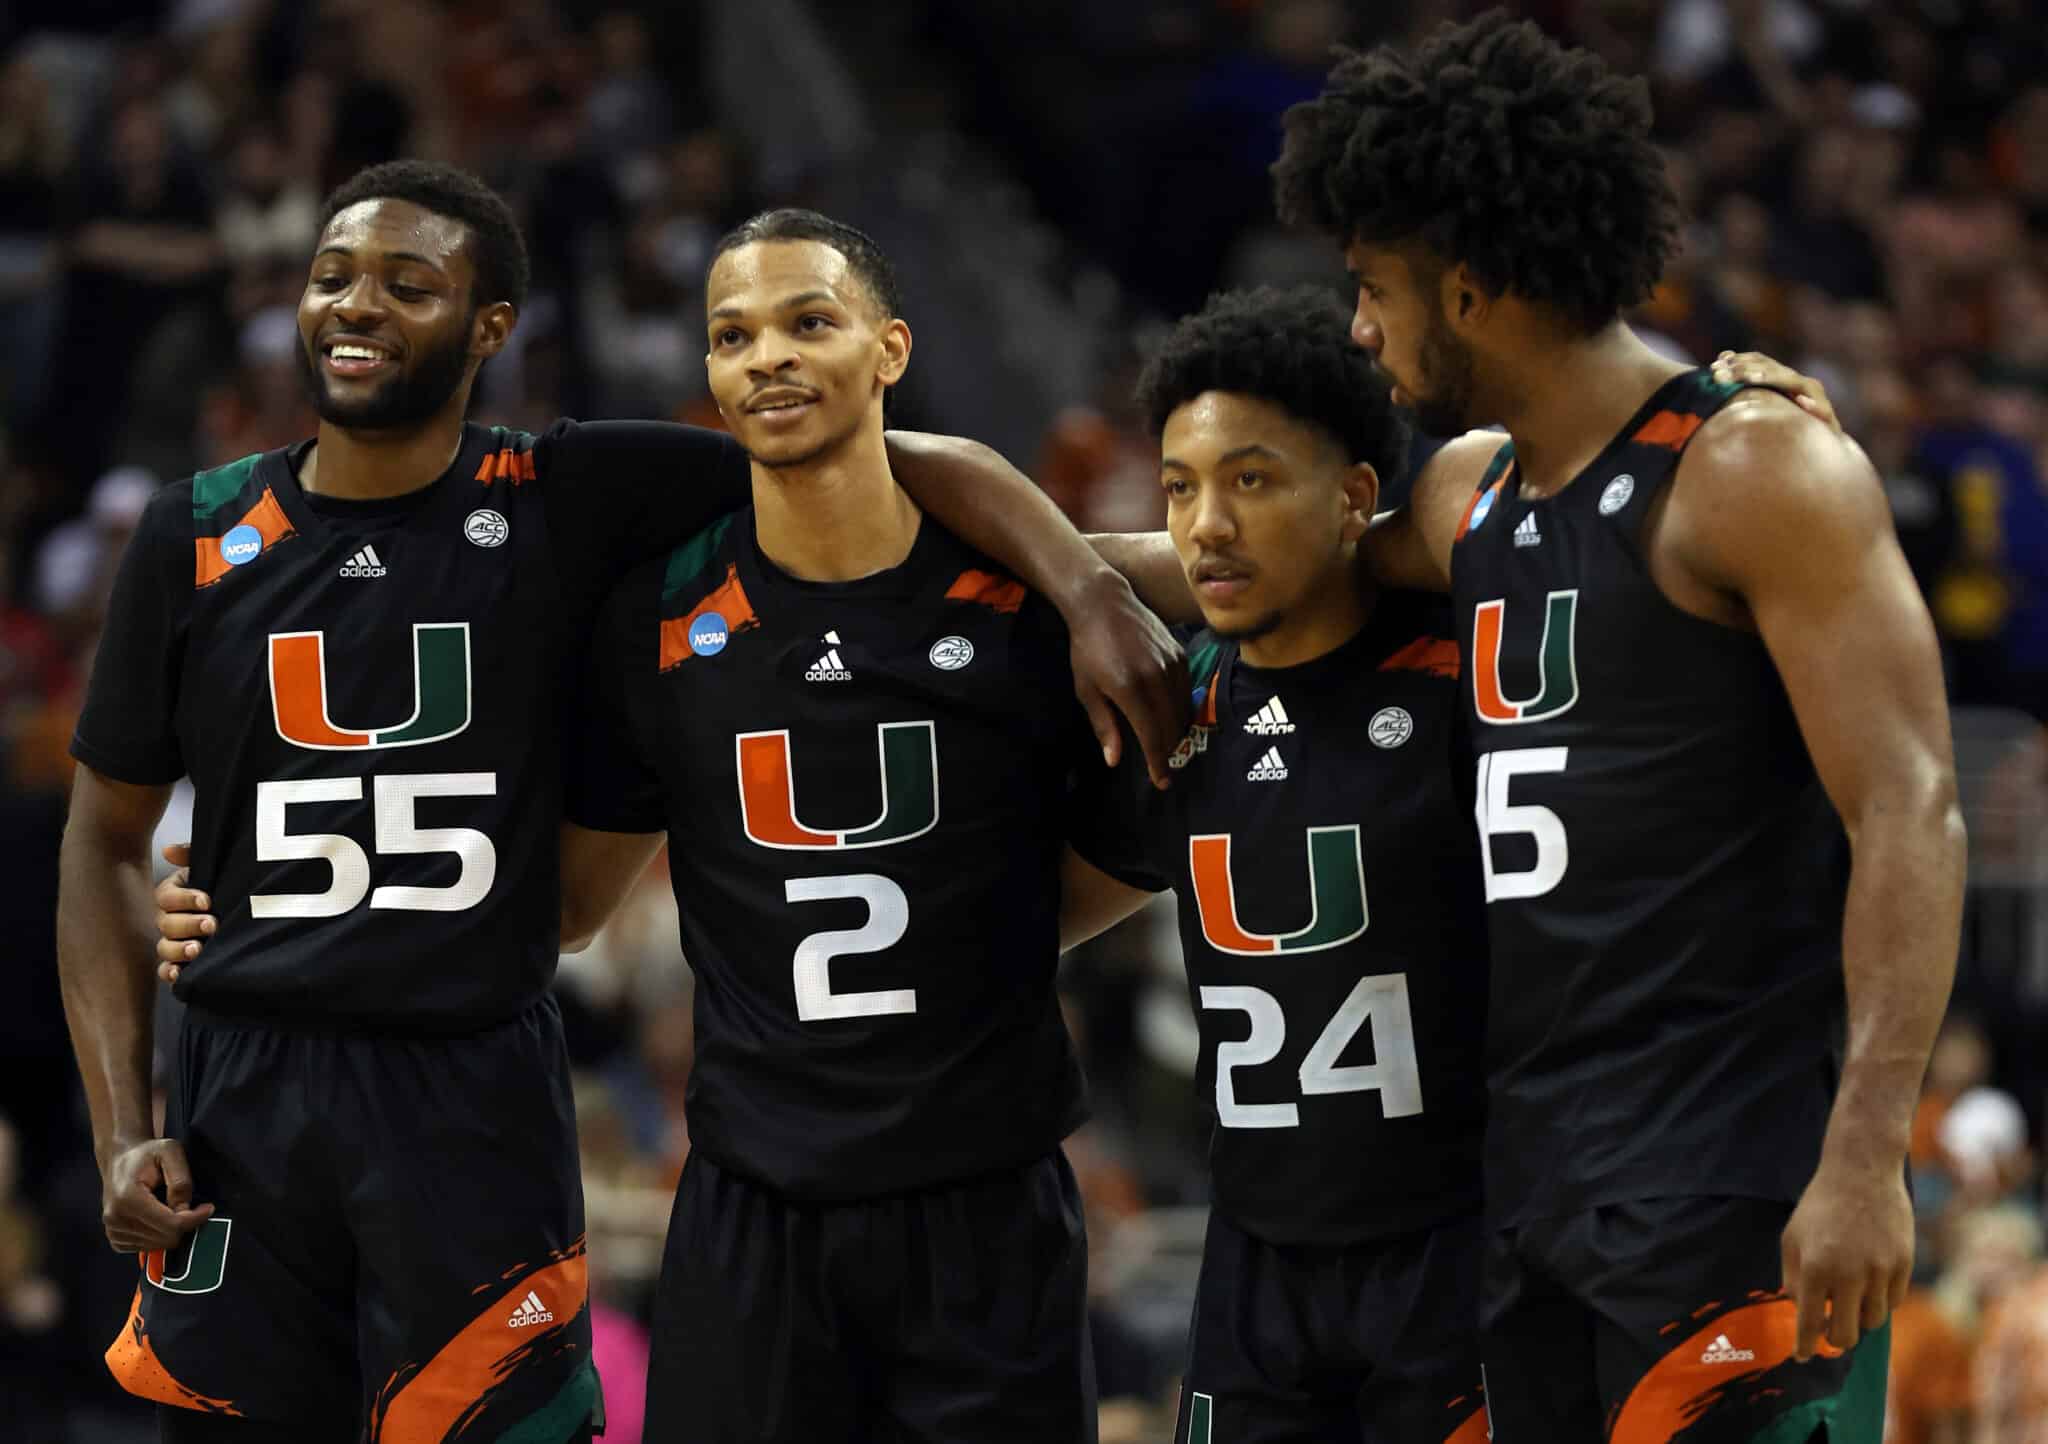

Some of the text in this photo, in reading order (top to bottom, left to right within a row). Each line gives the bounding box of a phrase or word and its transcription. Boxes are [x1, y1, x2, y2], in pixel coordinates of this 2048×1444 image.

[471, 522, 505, 534] ACC
[226, 541, 259, 557] NCAA
[339, 565, 387, 578] adidas
[694, 631, 727, 647] NCAA
[1472, 589, 1579, 725] U
[805, 669, 853, 681] adidas
[268, 622, 472, 751] U
[1247, 767, 1289, 782] adidas
[736, 720, 940, 850] U
[249, 772, 497, 919] 55
[1190, 824, 1369, 957] U
[784, 873, 917, 1022] 2
[1199, 973, 1424, 1129] 24
[508, 1311, 554, 1329] adidas
[1701, 1349, 1755, 1364] adidas
